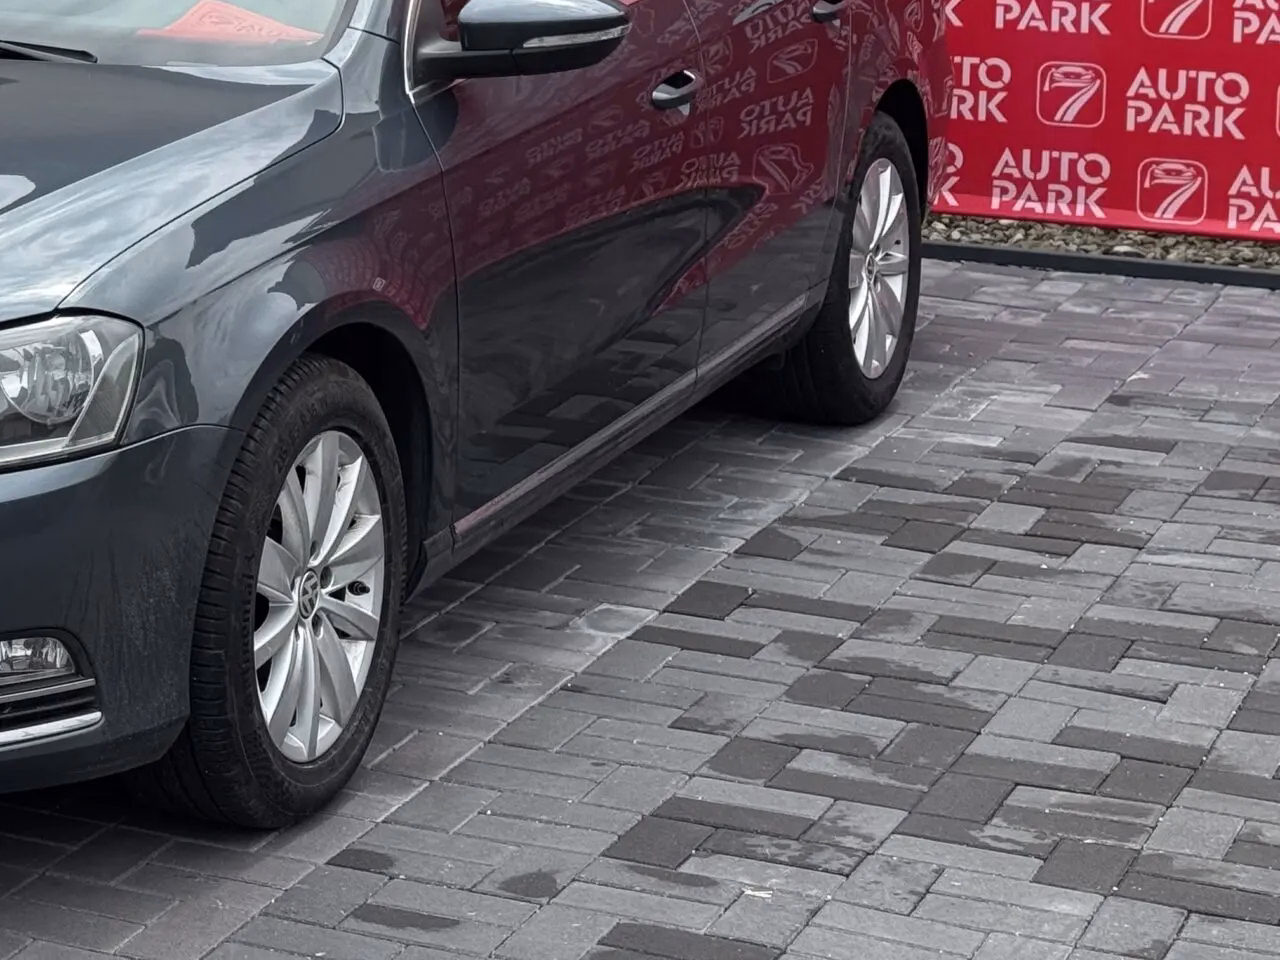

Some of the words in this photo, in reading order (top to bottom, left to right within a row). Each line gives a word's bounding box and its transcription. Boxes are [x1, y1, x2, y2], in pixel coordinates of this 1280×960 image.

[1127, 68, 1249, 104] AUTO
[1127, 100, 1245, 139] PARK
[992, 148, 1110, 184] AUTO
[991, 180, 1106, 218] PARK
